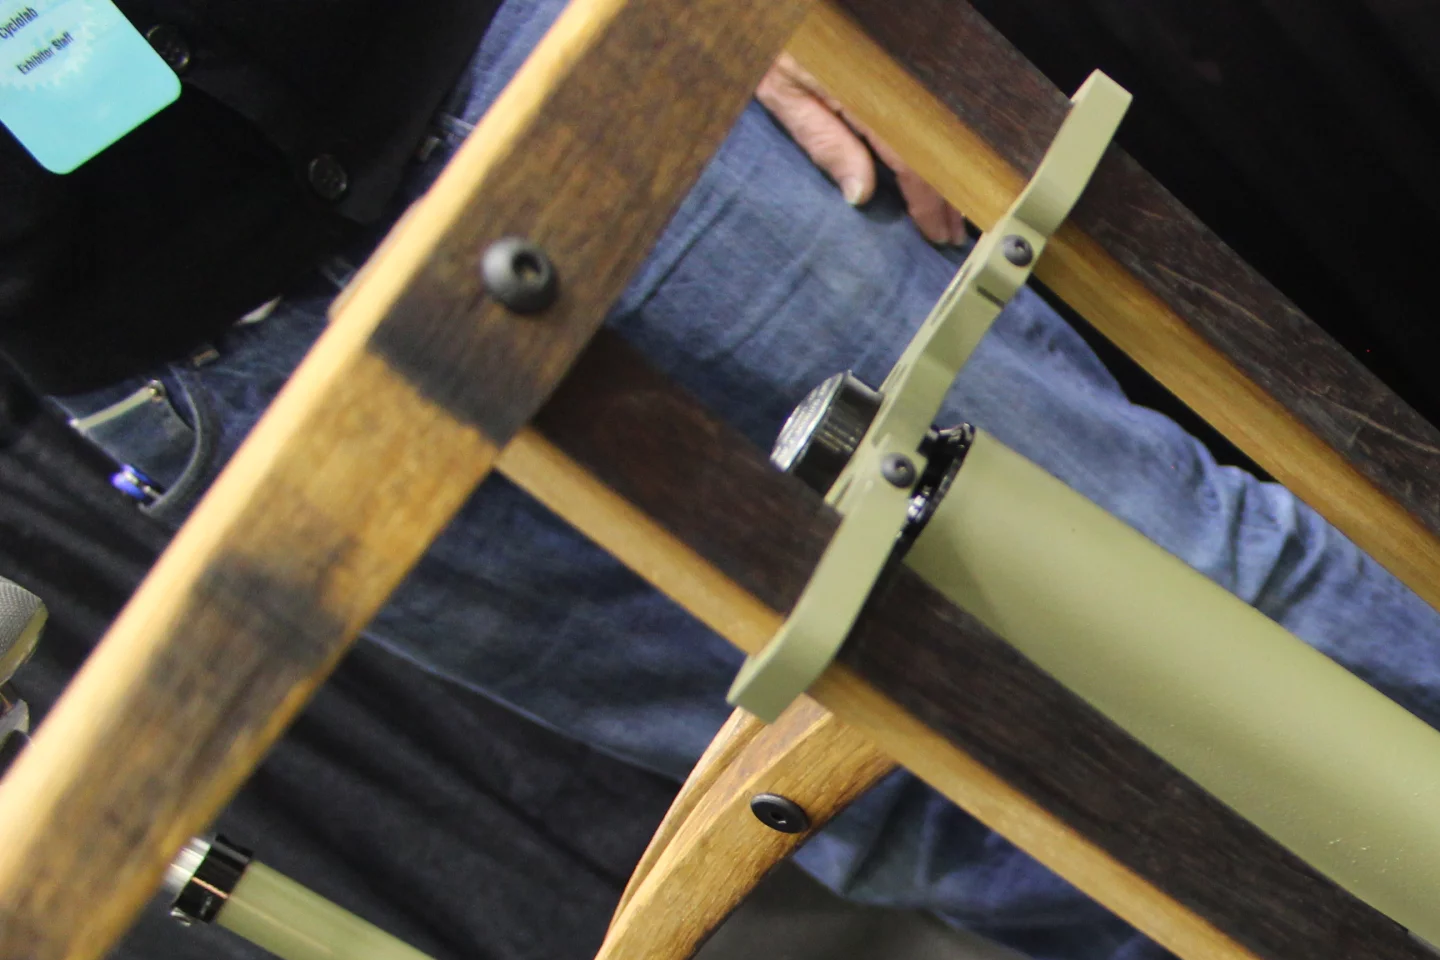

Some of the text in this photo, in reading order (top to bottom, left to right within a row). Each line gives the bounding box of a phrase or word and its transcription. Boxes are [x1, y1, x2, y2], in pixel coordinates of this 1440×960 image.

[0, 6, 38, 39] Cyclolab
[16, 31, 74, 75] Exhibitor Staff
